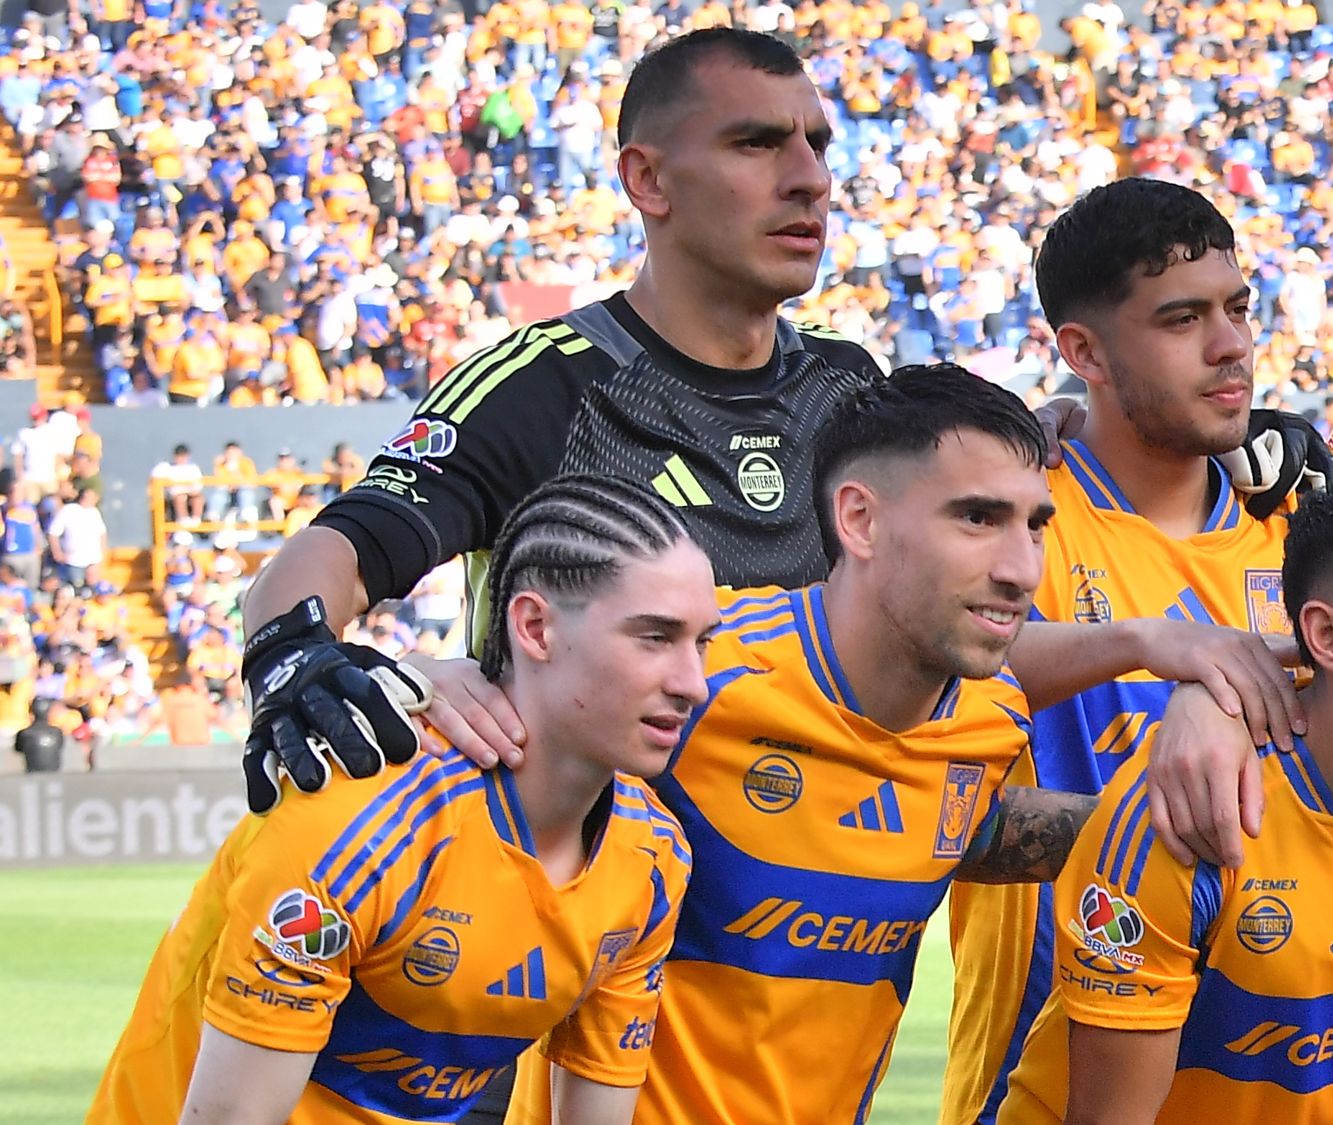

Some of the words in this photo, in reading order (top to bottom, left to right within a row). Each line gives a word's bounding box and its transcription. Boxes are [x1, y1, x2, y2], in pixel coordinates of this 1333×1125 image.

[742, 436, 781, 449] CEMEX
[740, 474, 782, 489] MONTERREY
[1250, 576, 1283, 590] TIGR
[1254, 879, 1298, 891] CEMEX
[436, 907, 474, 925] CEMEX
[1237, 917, 1292, 934] MONTERREY
[1084, 935, 1120, 959] BBVA
[1122, 952, 1144, 965] MX
[1059, 965, 1165, 997] CHIREY
[226, 976, 342, 1013] CHIREY
